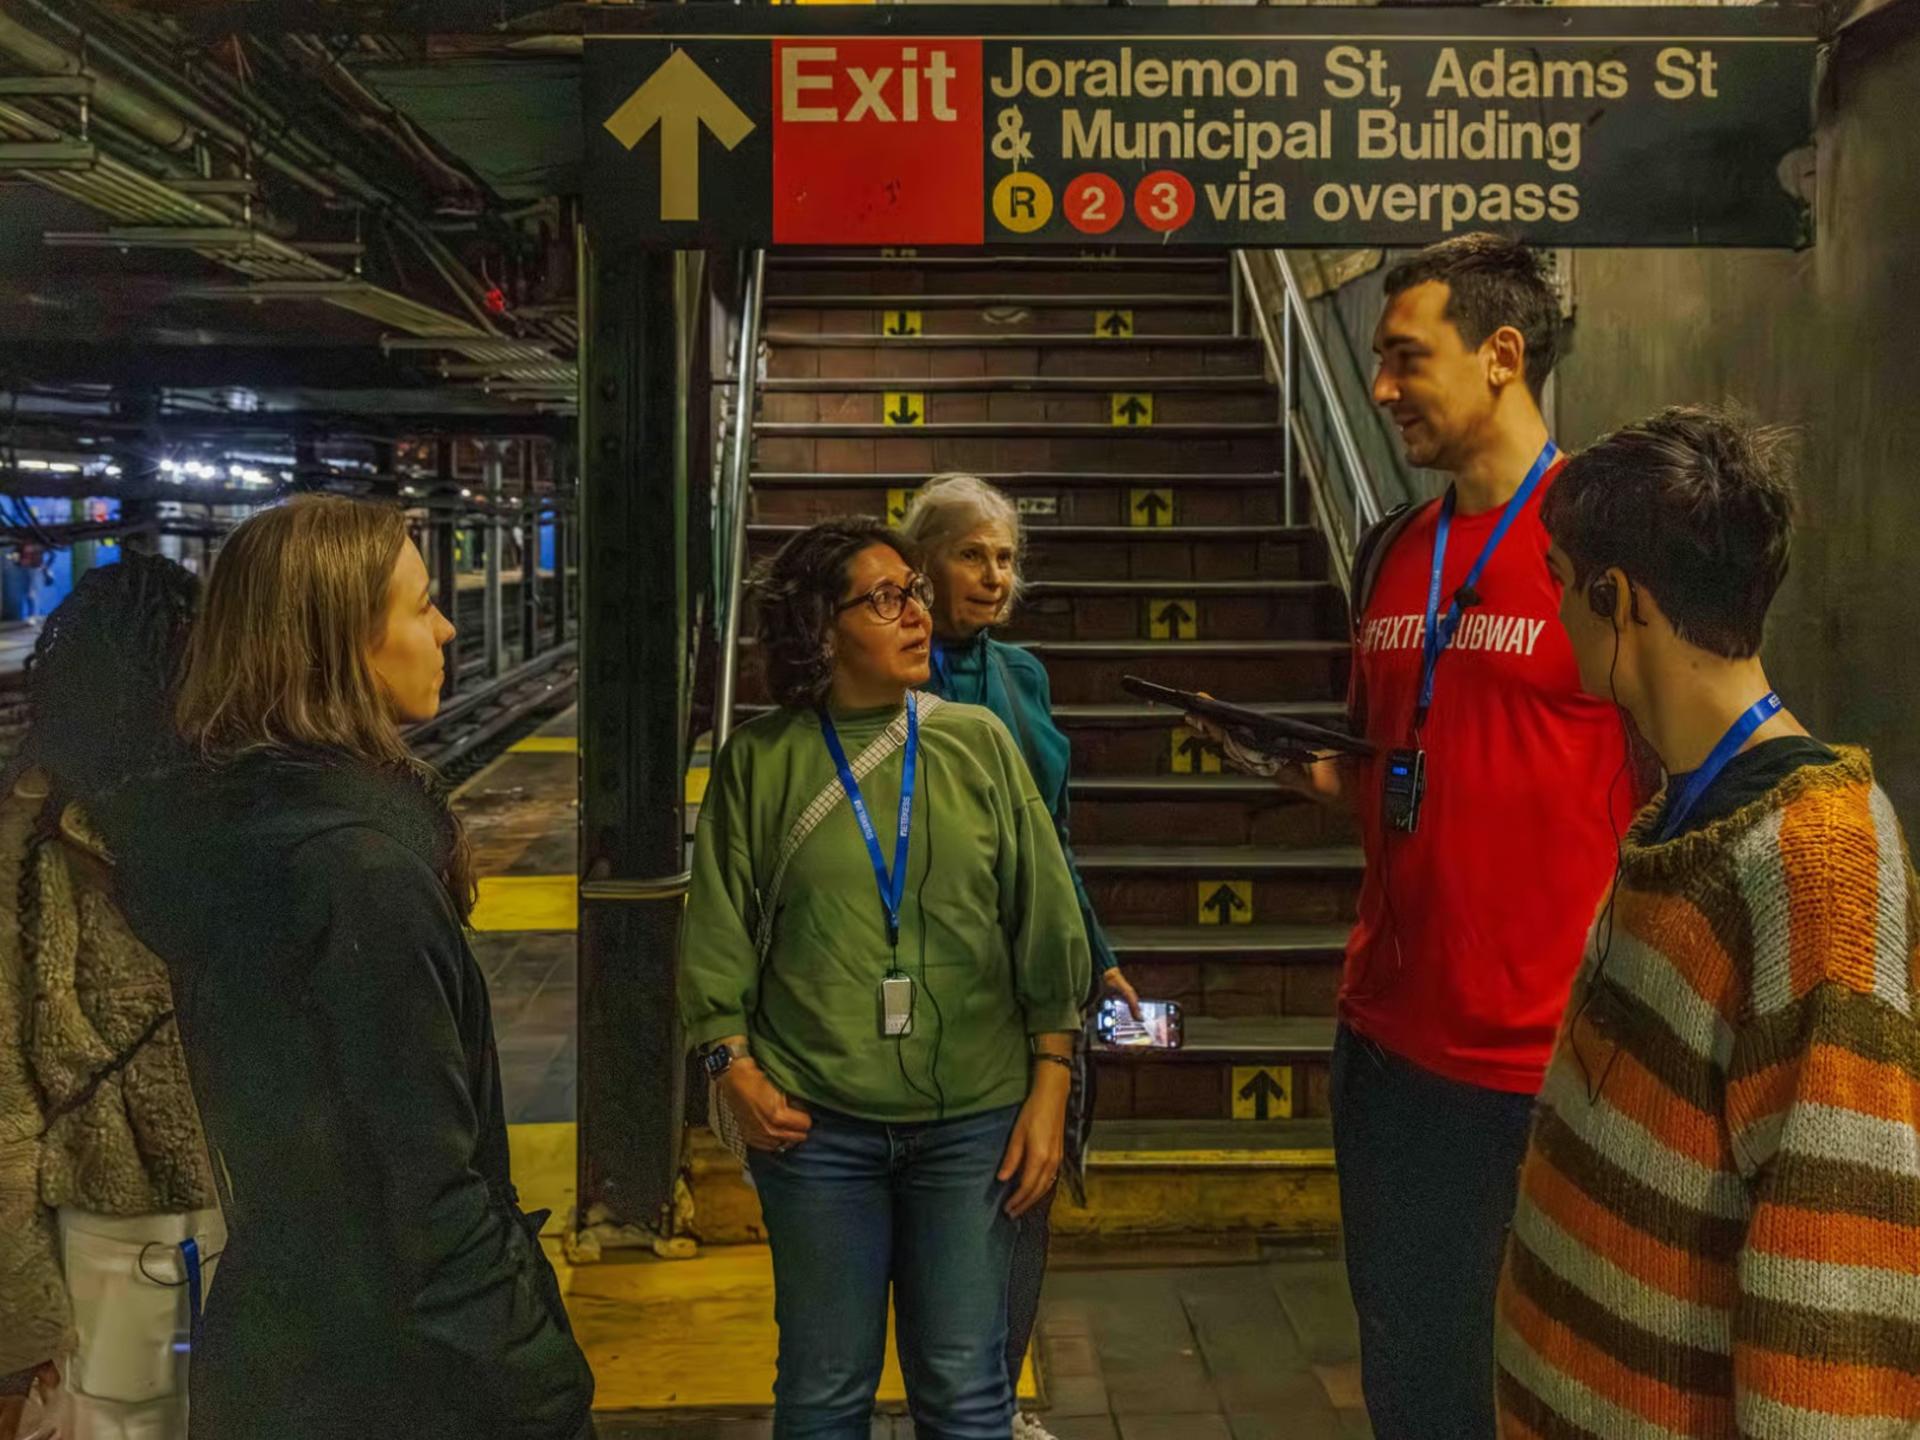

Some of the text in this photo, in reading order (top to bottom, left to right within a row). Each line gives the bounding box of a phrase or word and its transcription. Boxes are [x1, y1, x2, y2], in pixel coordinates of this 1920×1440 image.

[781, 47, 958, 122] Exit
[990, 45, 1719, 107] Joralemon St, Adams St
[990, 108, 1582, 172] & Municipal Building
[1010, 171, 1580, 231] R 2 3 via overpass
